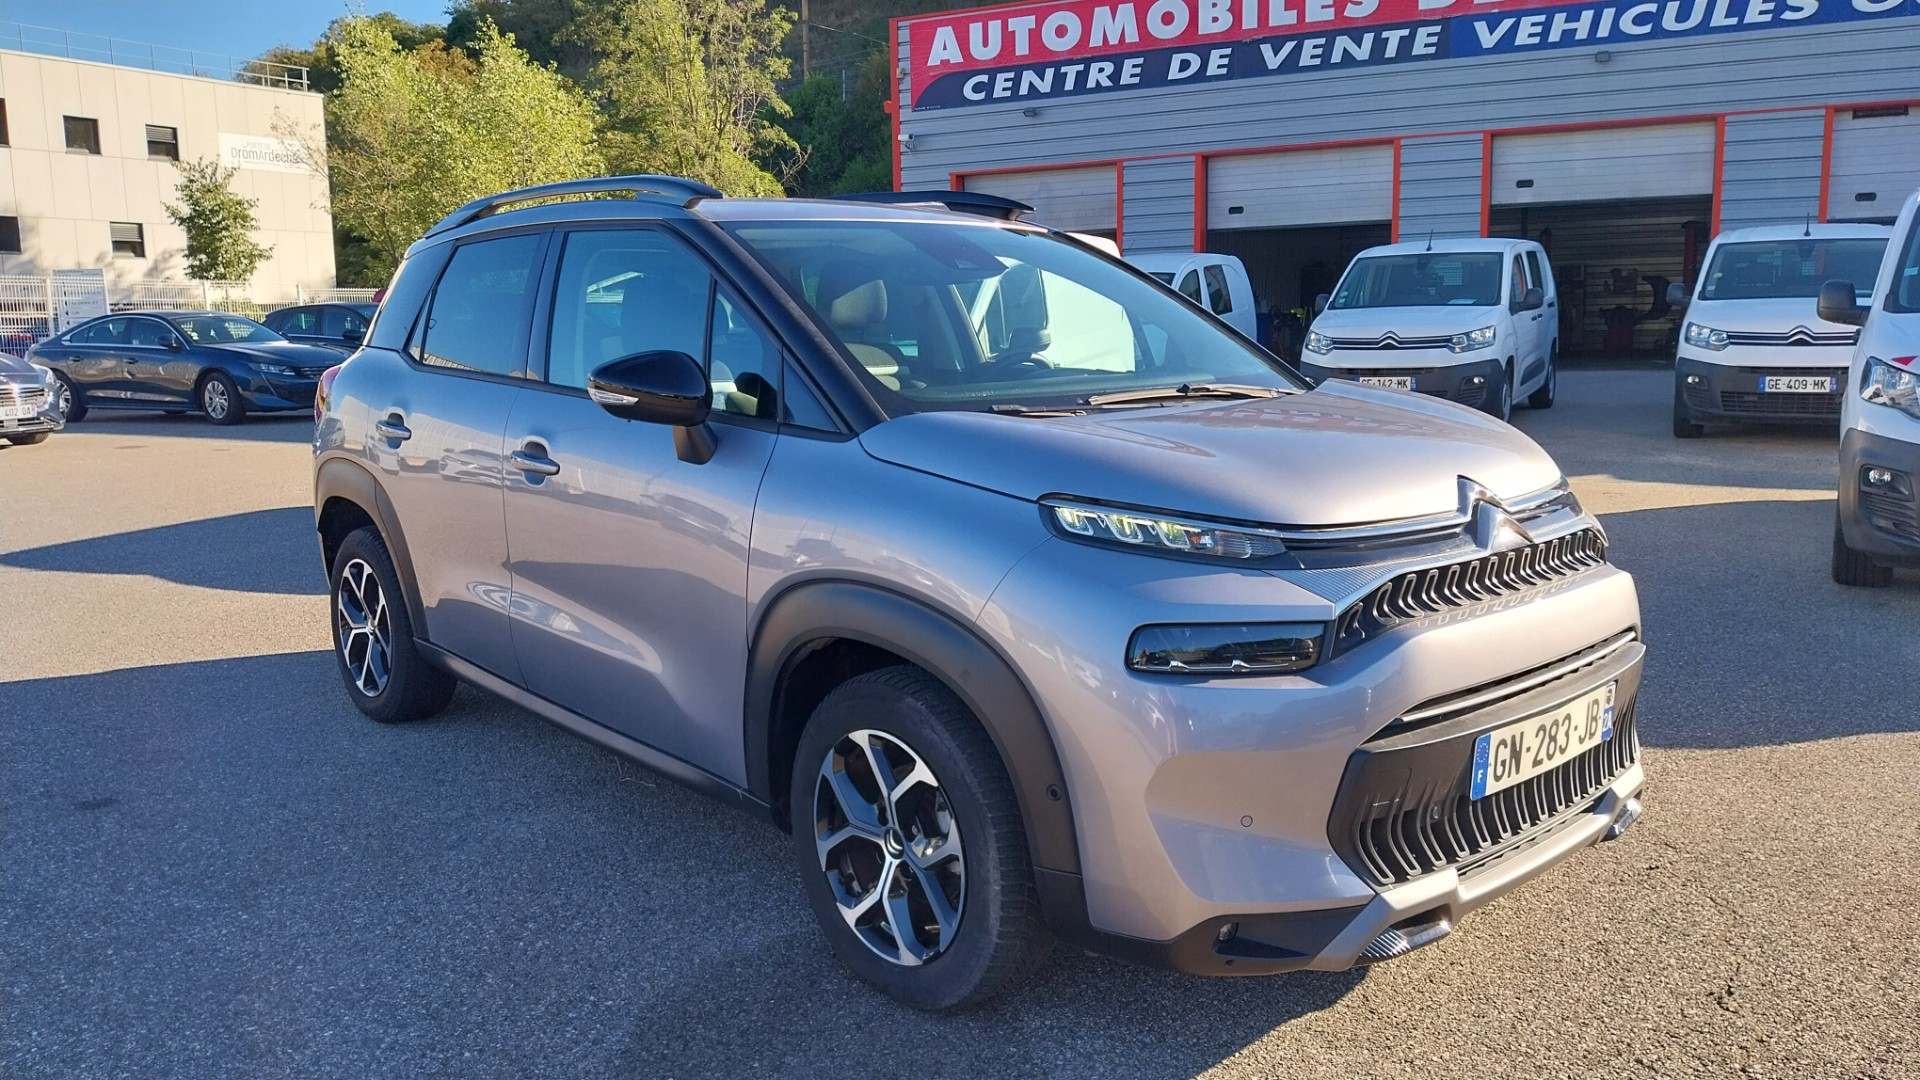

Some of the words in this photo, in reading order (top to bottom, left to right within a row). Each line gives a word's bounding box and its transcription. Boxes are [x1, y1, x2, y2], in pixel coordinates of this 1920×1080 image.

[962, 57, 1144, 101] CENTRE
[1167, 47, 1233, 80] DE
[1259, 25, 1442, 70] VENTE
[1473, 0, 1820, 49] VEHICULES
[1477, 769, 1484, 784] F
[1493, 698, 1600, 783] GN-283-JB
